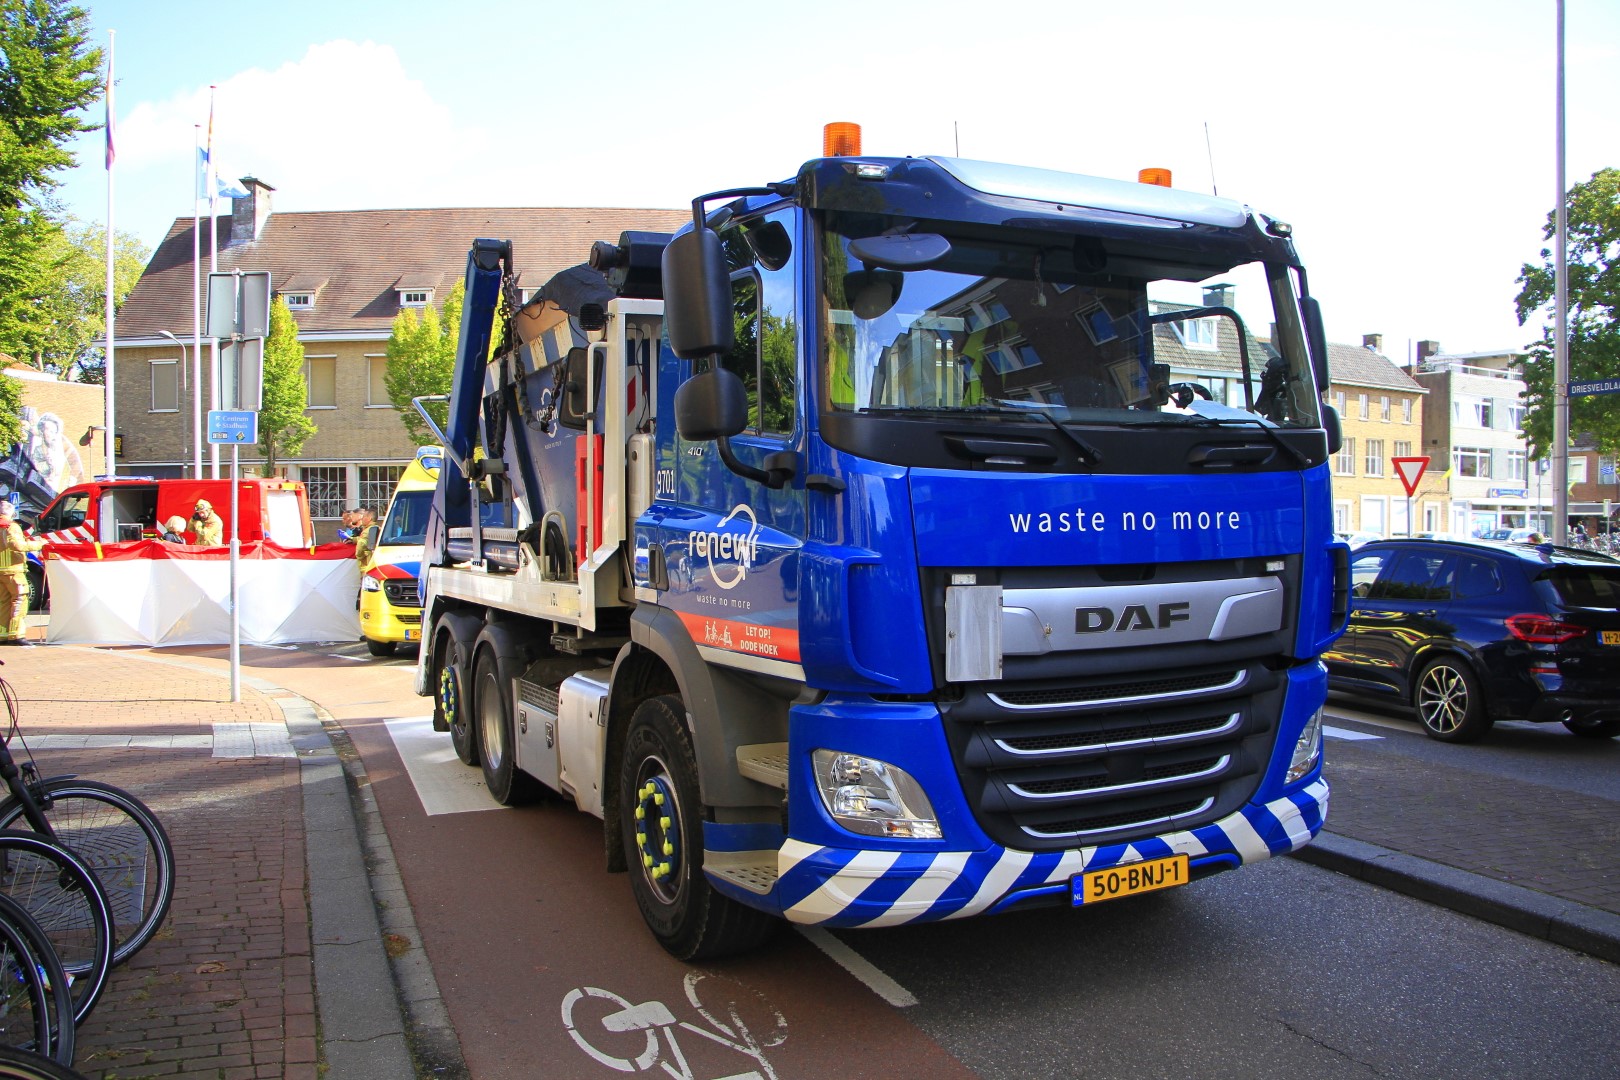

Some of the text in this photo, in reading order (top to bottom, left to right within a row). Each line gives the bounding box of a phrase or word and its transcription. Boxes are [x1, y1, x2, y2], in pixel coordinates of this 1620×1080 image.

[687, 446, 703, 456] 410
[656, 469, 675, 495] 9701
[1009, 507, 1240, 533] waste no more
[696, 593, 751, 610] waste no more
[1075, 601, 1190, 634] DAF
[745, 625, 771, 640] LET OP!
[740, 639, 779, 656] DODE HOEK
[1093, 860, 1179, 897] 50-BNJ-1
